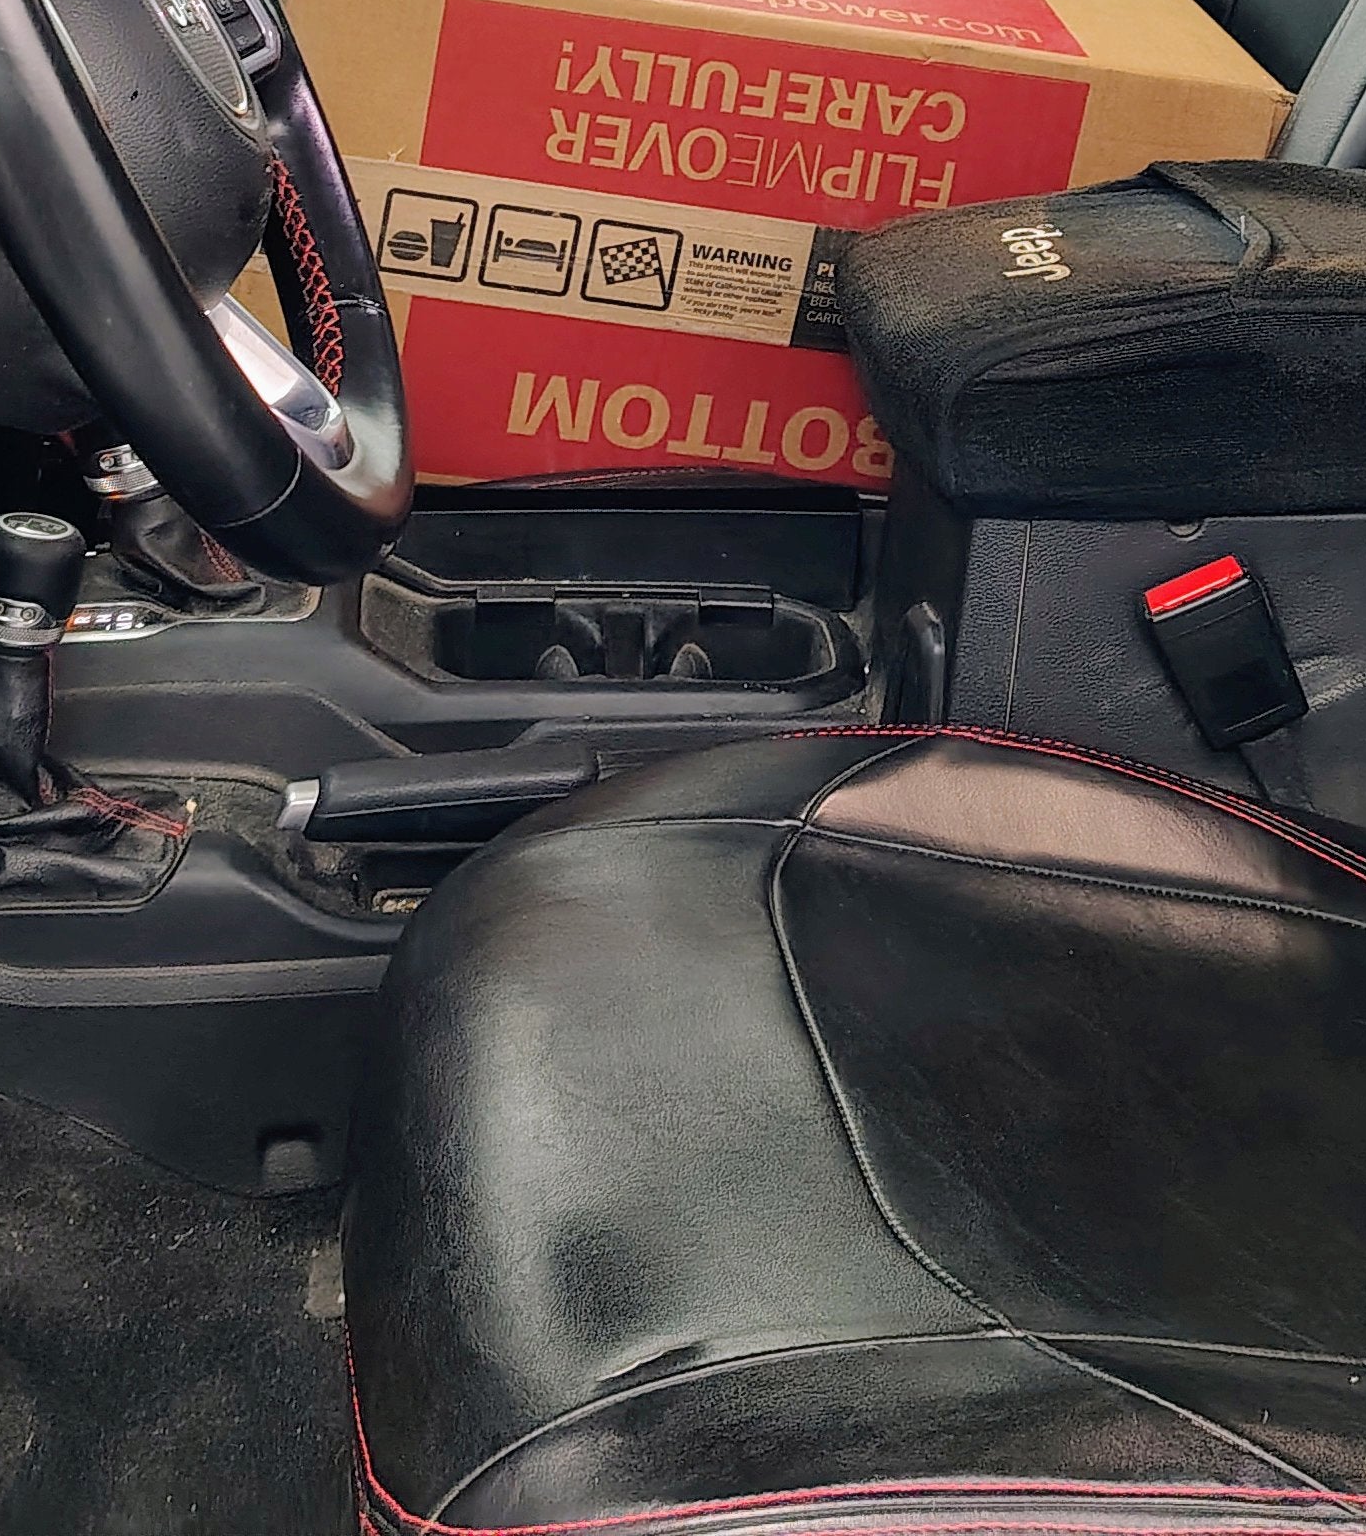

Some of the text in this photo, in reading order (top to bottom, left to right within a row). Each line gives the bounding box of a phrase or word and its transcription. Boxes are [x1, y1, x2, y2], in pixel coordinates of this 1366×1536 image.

[554, 40, 967, 142] CAREFULLY!
[692, 243, 793, 272] WARNING
[1000, 225, 1072, 282] Jeep
[506, 370, 896, 480] BOTTOM
